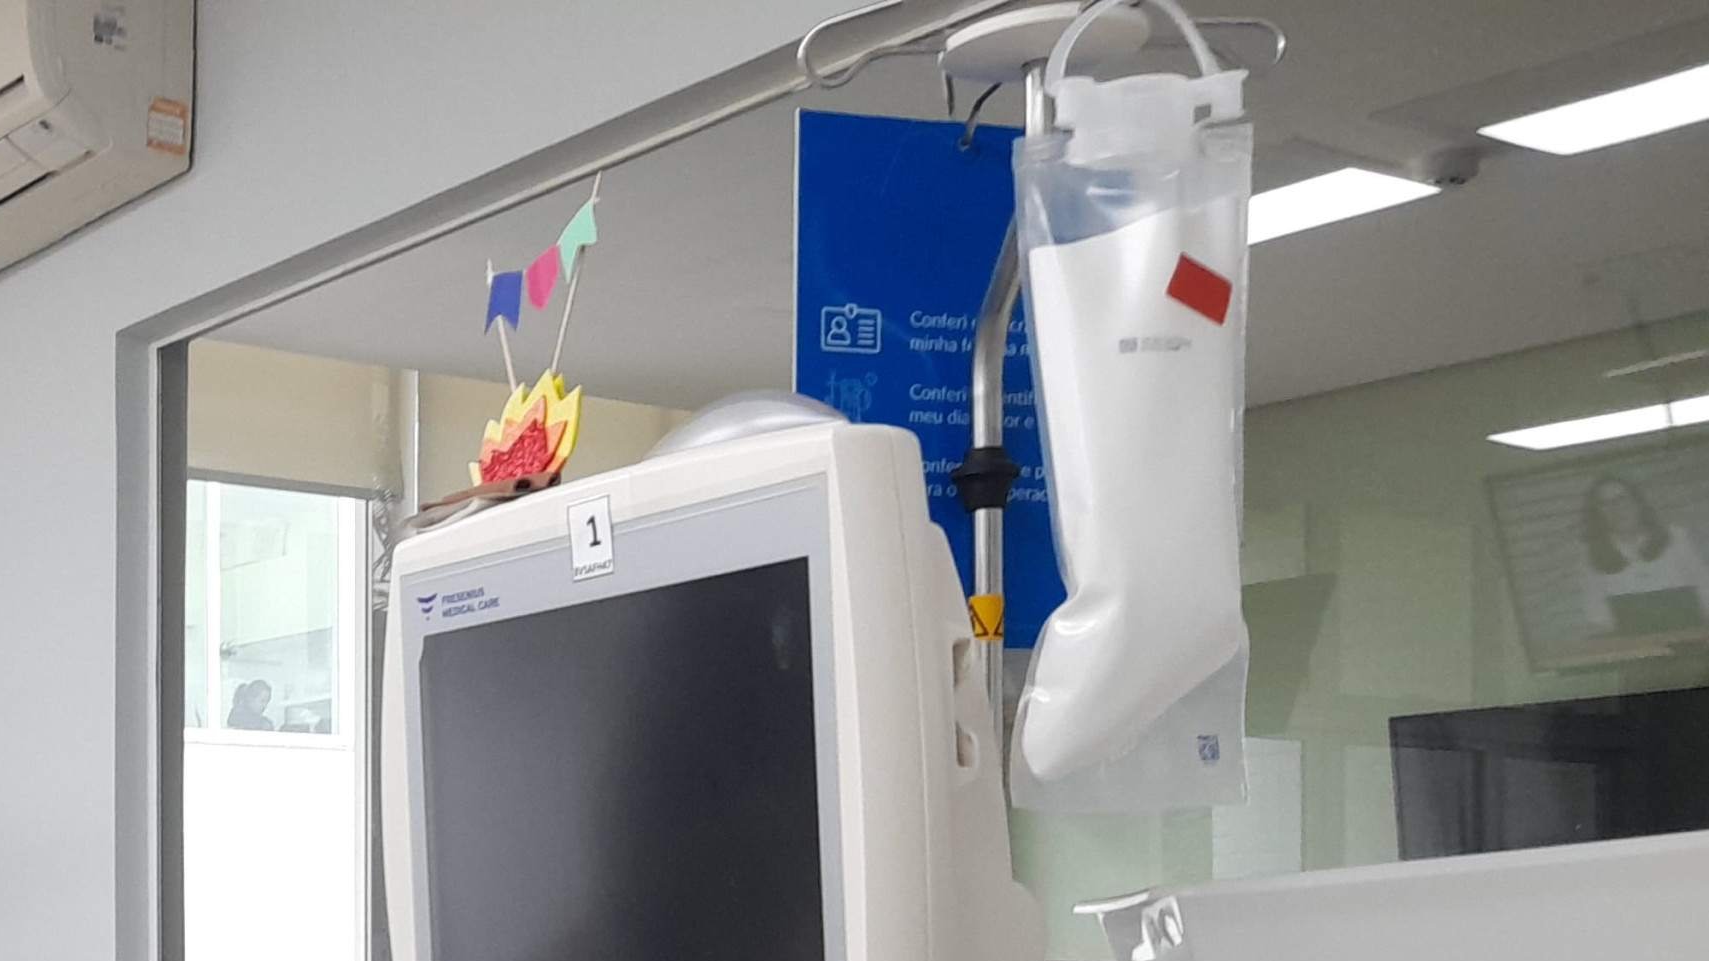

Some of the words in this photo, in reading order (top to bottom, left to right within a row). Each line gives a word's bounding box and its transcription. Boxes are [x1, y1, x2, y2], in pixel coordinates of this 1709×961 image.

[909, 338, 958, 353] minha
[909, 412, 944, 425] meu
[586, 515, 602, 548] 1
